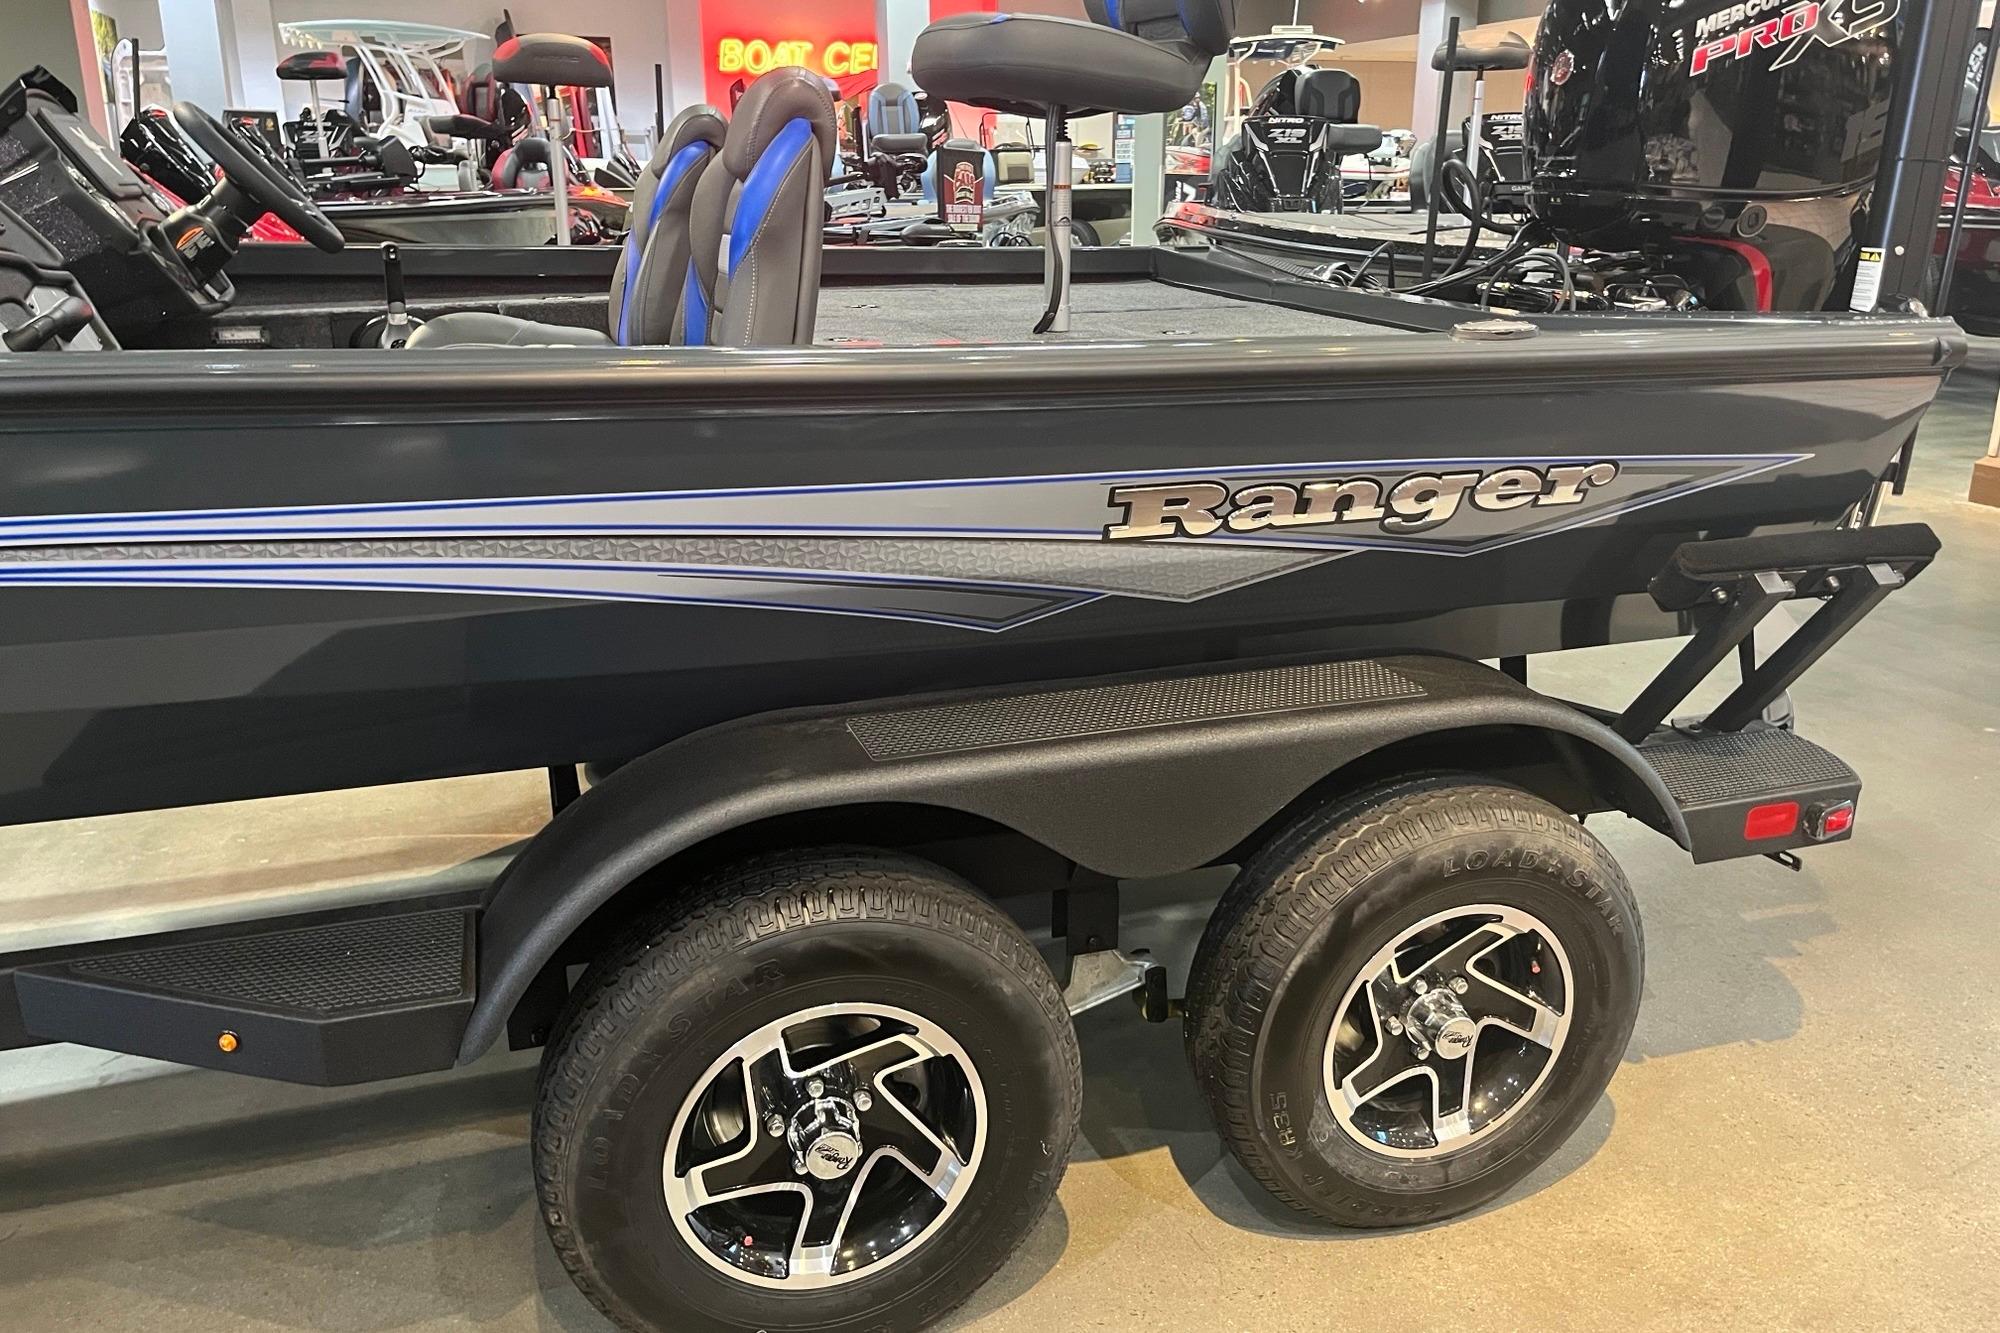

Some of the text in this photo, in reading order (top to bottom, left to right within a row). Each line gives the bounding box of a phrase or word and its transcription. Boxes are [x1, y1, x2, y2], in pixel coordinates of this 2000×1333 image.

[1695, 0, 1787, 38] MERCU
[719, 38, 879, 75] BOAT CE
[1101, 460, 1620, 541] Ranger
[1443, 847, 1626, 937] LOAD STAR
